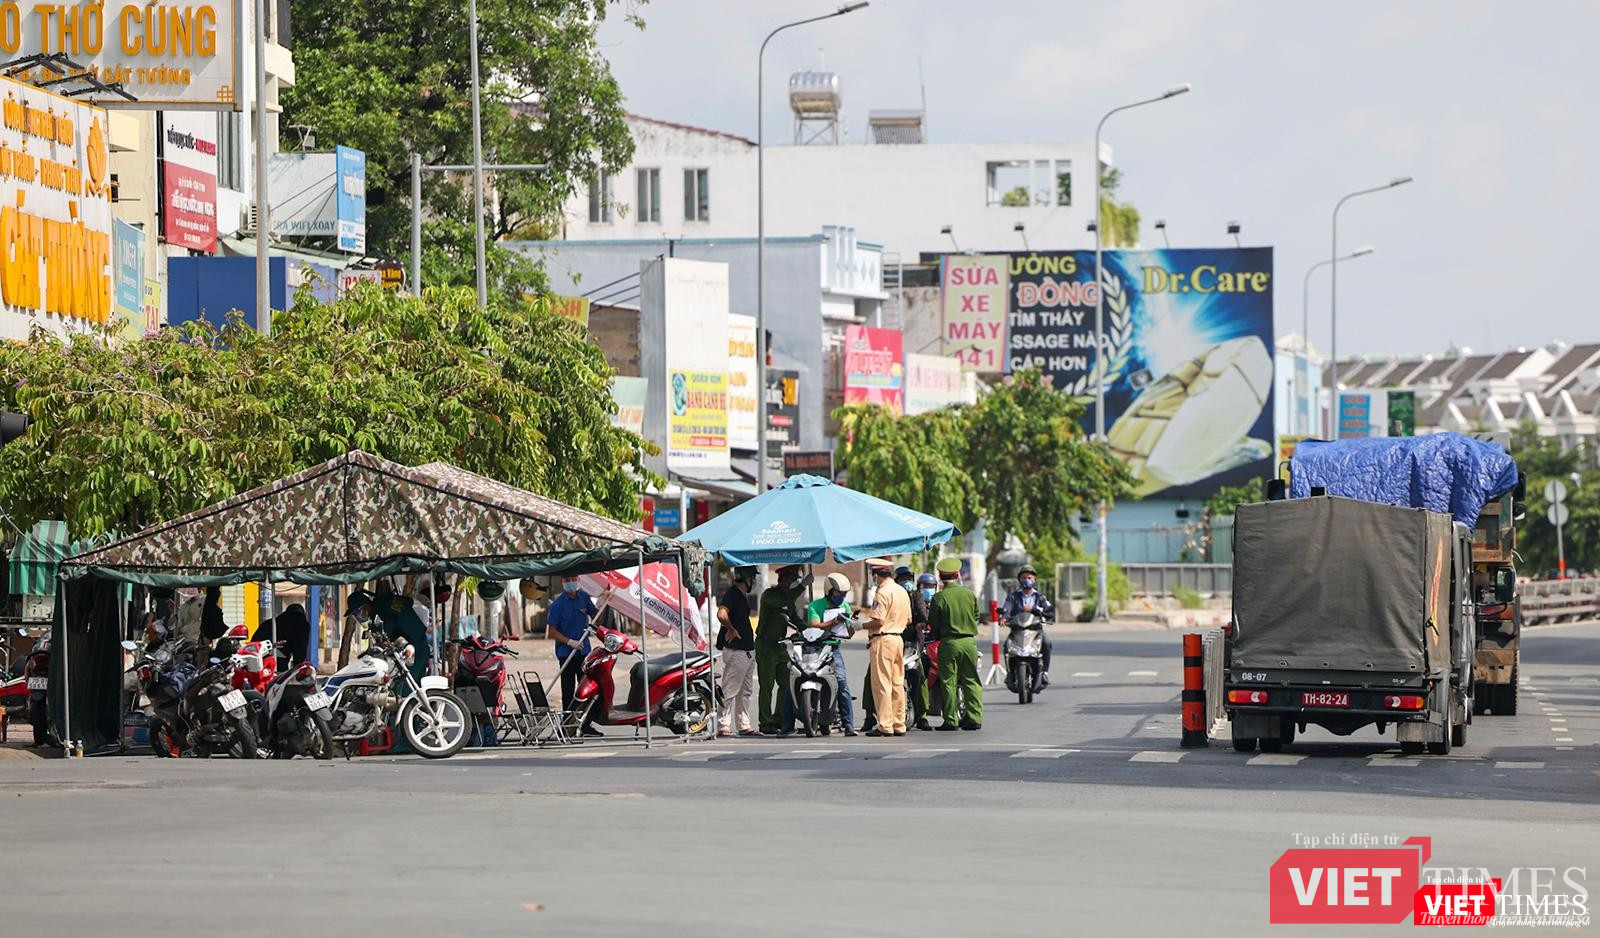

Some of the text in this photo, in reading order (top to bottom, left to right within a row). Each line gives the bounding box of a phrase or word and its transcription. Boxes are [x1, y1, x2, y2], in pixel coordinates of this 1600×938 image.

[312, 220, 336, 231] XOAY
[951, 262, 999, 286] SỬA
[1142, 264, 1269, 294] Dr.Care
[961, 295, 990, 313] XE
[948, 316, 1001, 340] MÁY
[1009, 333, 1070, 349] SSAGE
[1241, 672, 1267, 682] 08-07
[1303, 692, 1348, 706] TH-82-24
